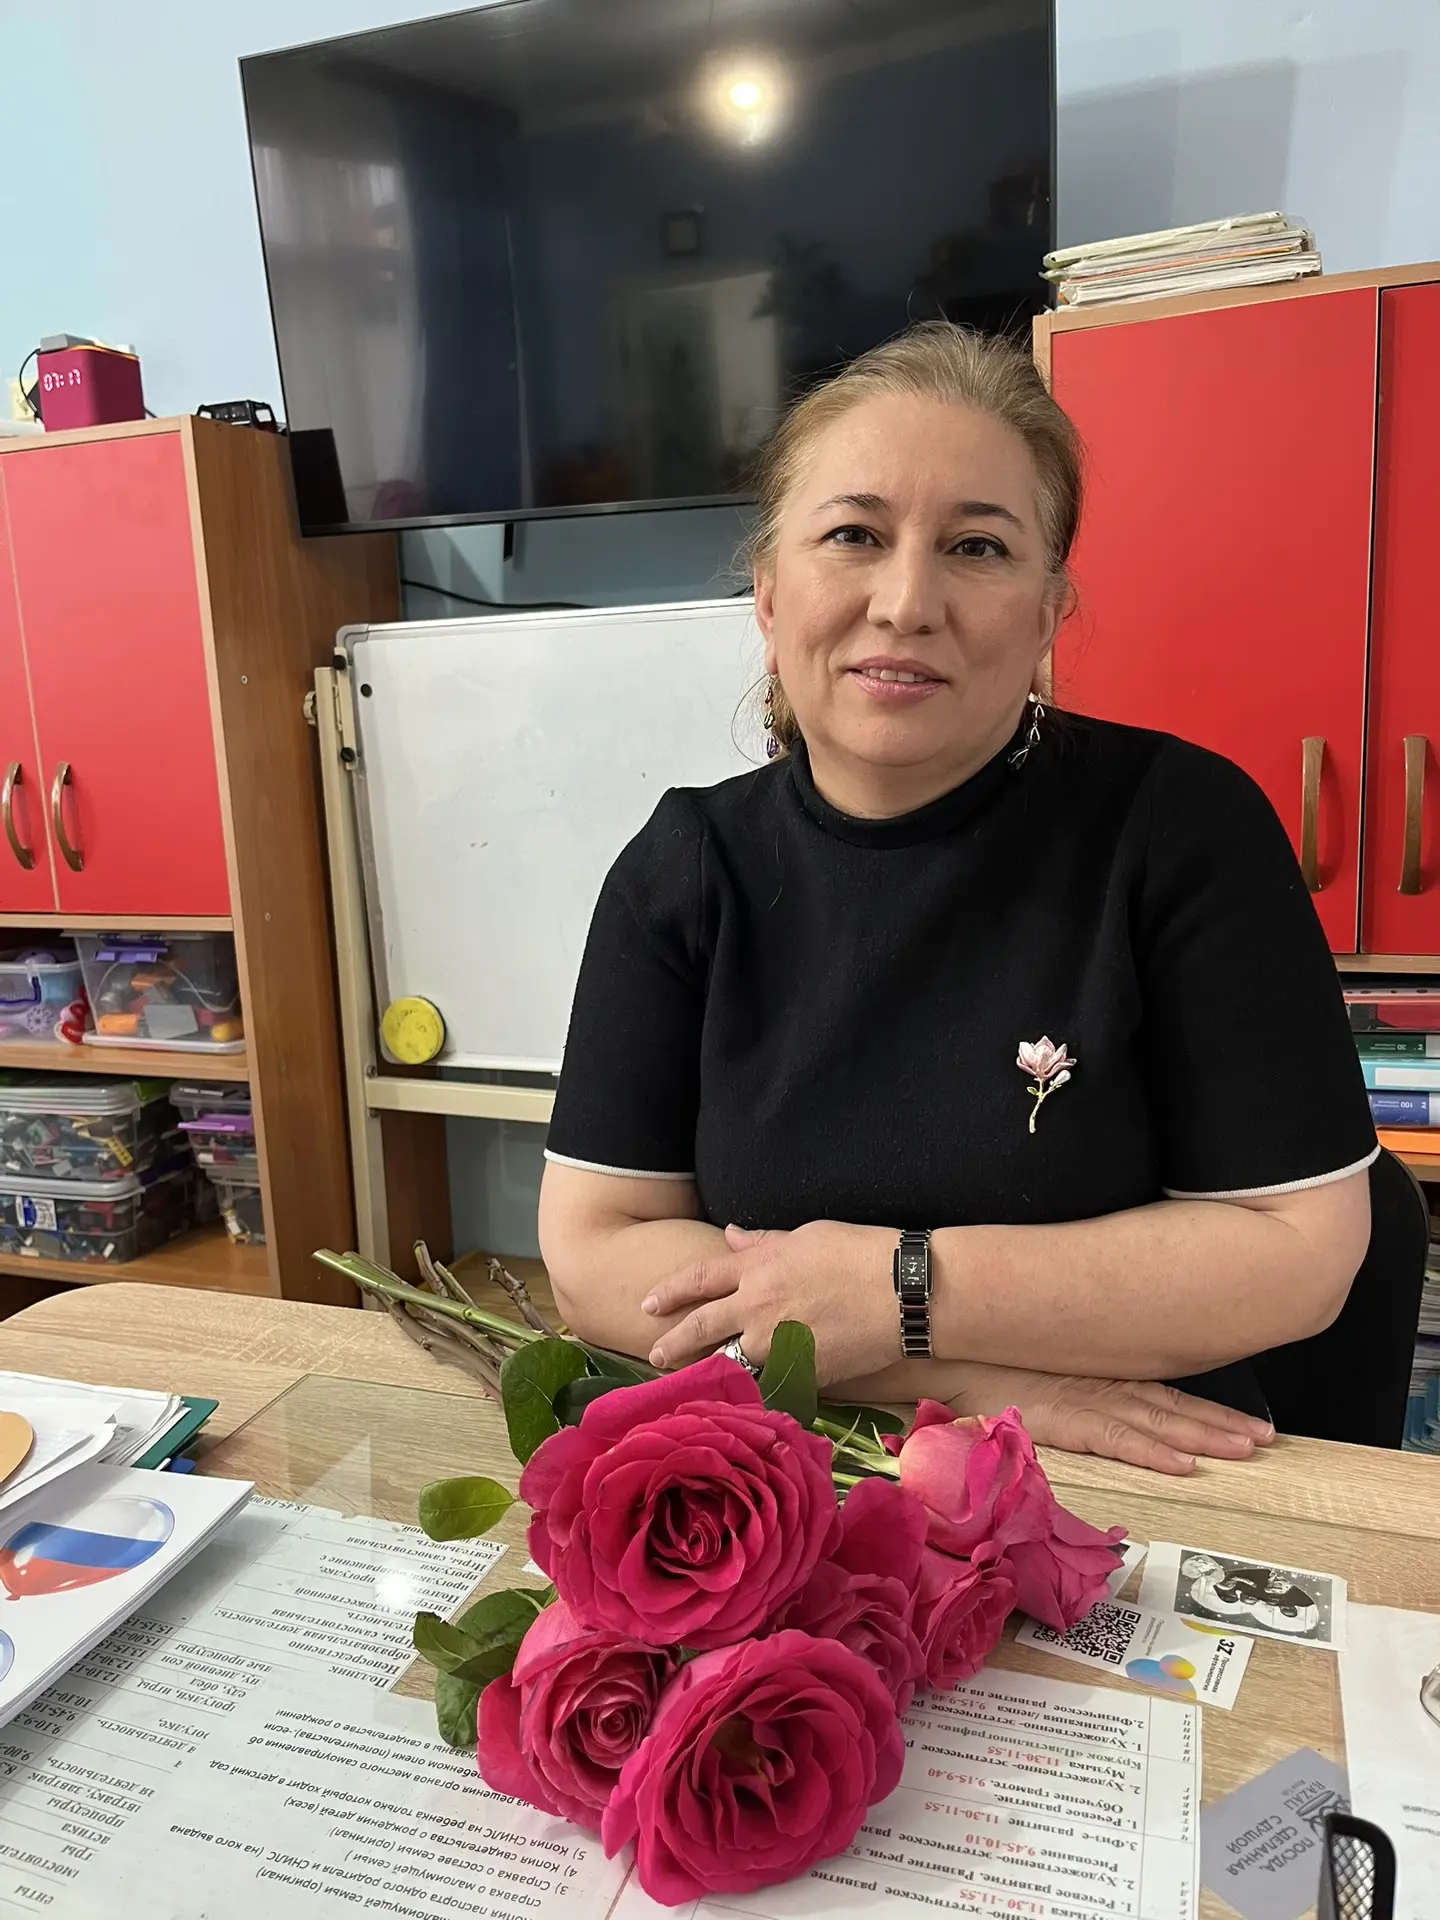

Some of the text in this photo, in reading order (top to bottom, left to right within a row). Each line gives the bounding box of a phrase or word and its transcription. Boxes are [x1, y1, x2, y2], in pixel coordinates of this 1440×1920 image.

[43, 368, 81, 392] 07:17
[346, 1537, 446, 1561] самостоятельная
[416, 1540, 497, 1560] деятельность
[420, 1564, 478, 1581] прогулки
[412, 1598, 452, 1613] литер
[418, 1588, 460, 1604] Подгот
[271, 1609, 378, 1638] самостоятельная
[214, 1608, 411, 1661] образовательная деятельность:
[175, 1644, 246, 1666] процедуры
[1216, 1639, 1235, 1655] 3Z
[161, 1655, 183, 1666] сон
[288, 1641, 401, 1675] Непосредственно
[183, 1661, 240, 1679] дневной
[241, 1672, 260, 1685] ну,
[328, 1666, 390, 1688] Полдник
[137, 1678, 172, 1695] игры
[189, 1678, 246, 1698] еду, обед
[275, 1710, 334, 1727] рождении
[970, 1689, 1144, 1729] 2.Физическое развитие на
[997, 1705, 1040, 1720] /лепка
[97, 1719, 185, 1750] деятельность.
[931, 1704, 1141, 1751] 1. Художественно- эстетическое
[1043, 1714, 1128, 1736] Аппликация
[247, 1736, 264, 1745] об
[342, 1724, 422, 1747] свидетельстве
[0, 1741, 33, 1761] 9.00-
[265, 1740, 358, 1767] самоуправления
[391, 1752, 426, 1765] опеки
[209, 1760, 230, 1771] сад.
[359, 1762, 413, 1779] местного
[921, 1744, 1141, 1795] 2. Художественно- эстетическое
[987, 1746, 1125, 1779] Музыка 11.30-11.55
[1086, 1753, 1141, 1770] Кружок
[28, 1772, 84, 1795] завтрак
[48, 1757, 140, 1792] деятельность,
[229, 1766, 279, 1782] детский
[413, 1774, 460, 1791] органов
[285, 1780, 322, 1793] ходит
[462, 1786, 516, 1804] решения
[928, 1768, 1123, 1813] Обучение грамоте. 9.15-9.40
[320, 1788, 372, 1806] который
[46, 1797, 125, 1828] процедуры
[373, 1800, 413, 1817] только
[925, 1801, 999, 1824] 11.30-11.55
[994, 1794, 1136, 1829] 1. Речевое развитие.
[415, 1811, 467, 1829] ребенка
[467, 1824, 483, 1834] на
[1008, 1818, 1074, 1836] развитие
[61, 1823, 111, 1844] астика
[283, 1796, 578, 1877] 4) Копия свидетельства о рождения детей (всех)
[482, 1828, 527, 1846] СНИЛС
[1226, 1819, 1274, 1854] ДУШОЙ
[529, 1839, 569, 1856] Копия
[571, 1847, 587, 1863] 5)
[866, 1848, 904, 1863] речи.
[899, 1833, 992, 1859] эстетическое
[965, 1834, 1118, 1872] Рисование 9.45-10.10
[1226, 1826, 1298, 1876] СДЕЛАННАЯ
[1259, 1837, 1315, 1872] ПОСУДА,
[170, 1825, 488, 1915] паспорта одного родителя и СНИЛС (на кого выдана
[329, 1826, 569, 1895] 3) Справка о составе семьи (оригинал)
[352, 1853, 391, 1869] семьи
[907, 1858, 974, 1881] Развитие
[391, 1864, 476, 1891] малоимущей
[996, 1856, 1117, 1887] Художественно-
[256, 1866, 446, 1920] алоимущей семьи (оригинал)
[477, 1885, 486, 1894] о
[811, 1871, 982, 1914] эстетическое развитие
[980, 1873, 1052, 1894] развитие.
[1123, 1879, 1134, 1890] 2.
[489, 1888, 541, 1907] справка
[1007, 1899, 1044, 1915] 11.30
[1055, 1889, 1115, 1909] Речевое
[1121, 1902, 1131, 1912] 1.
